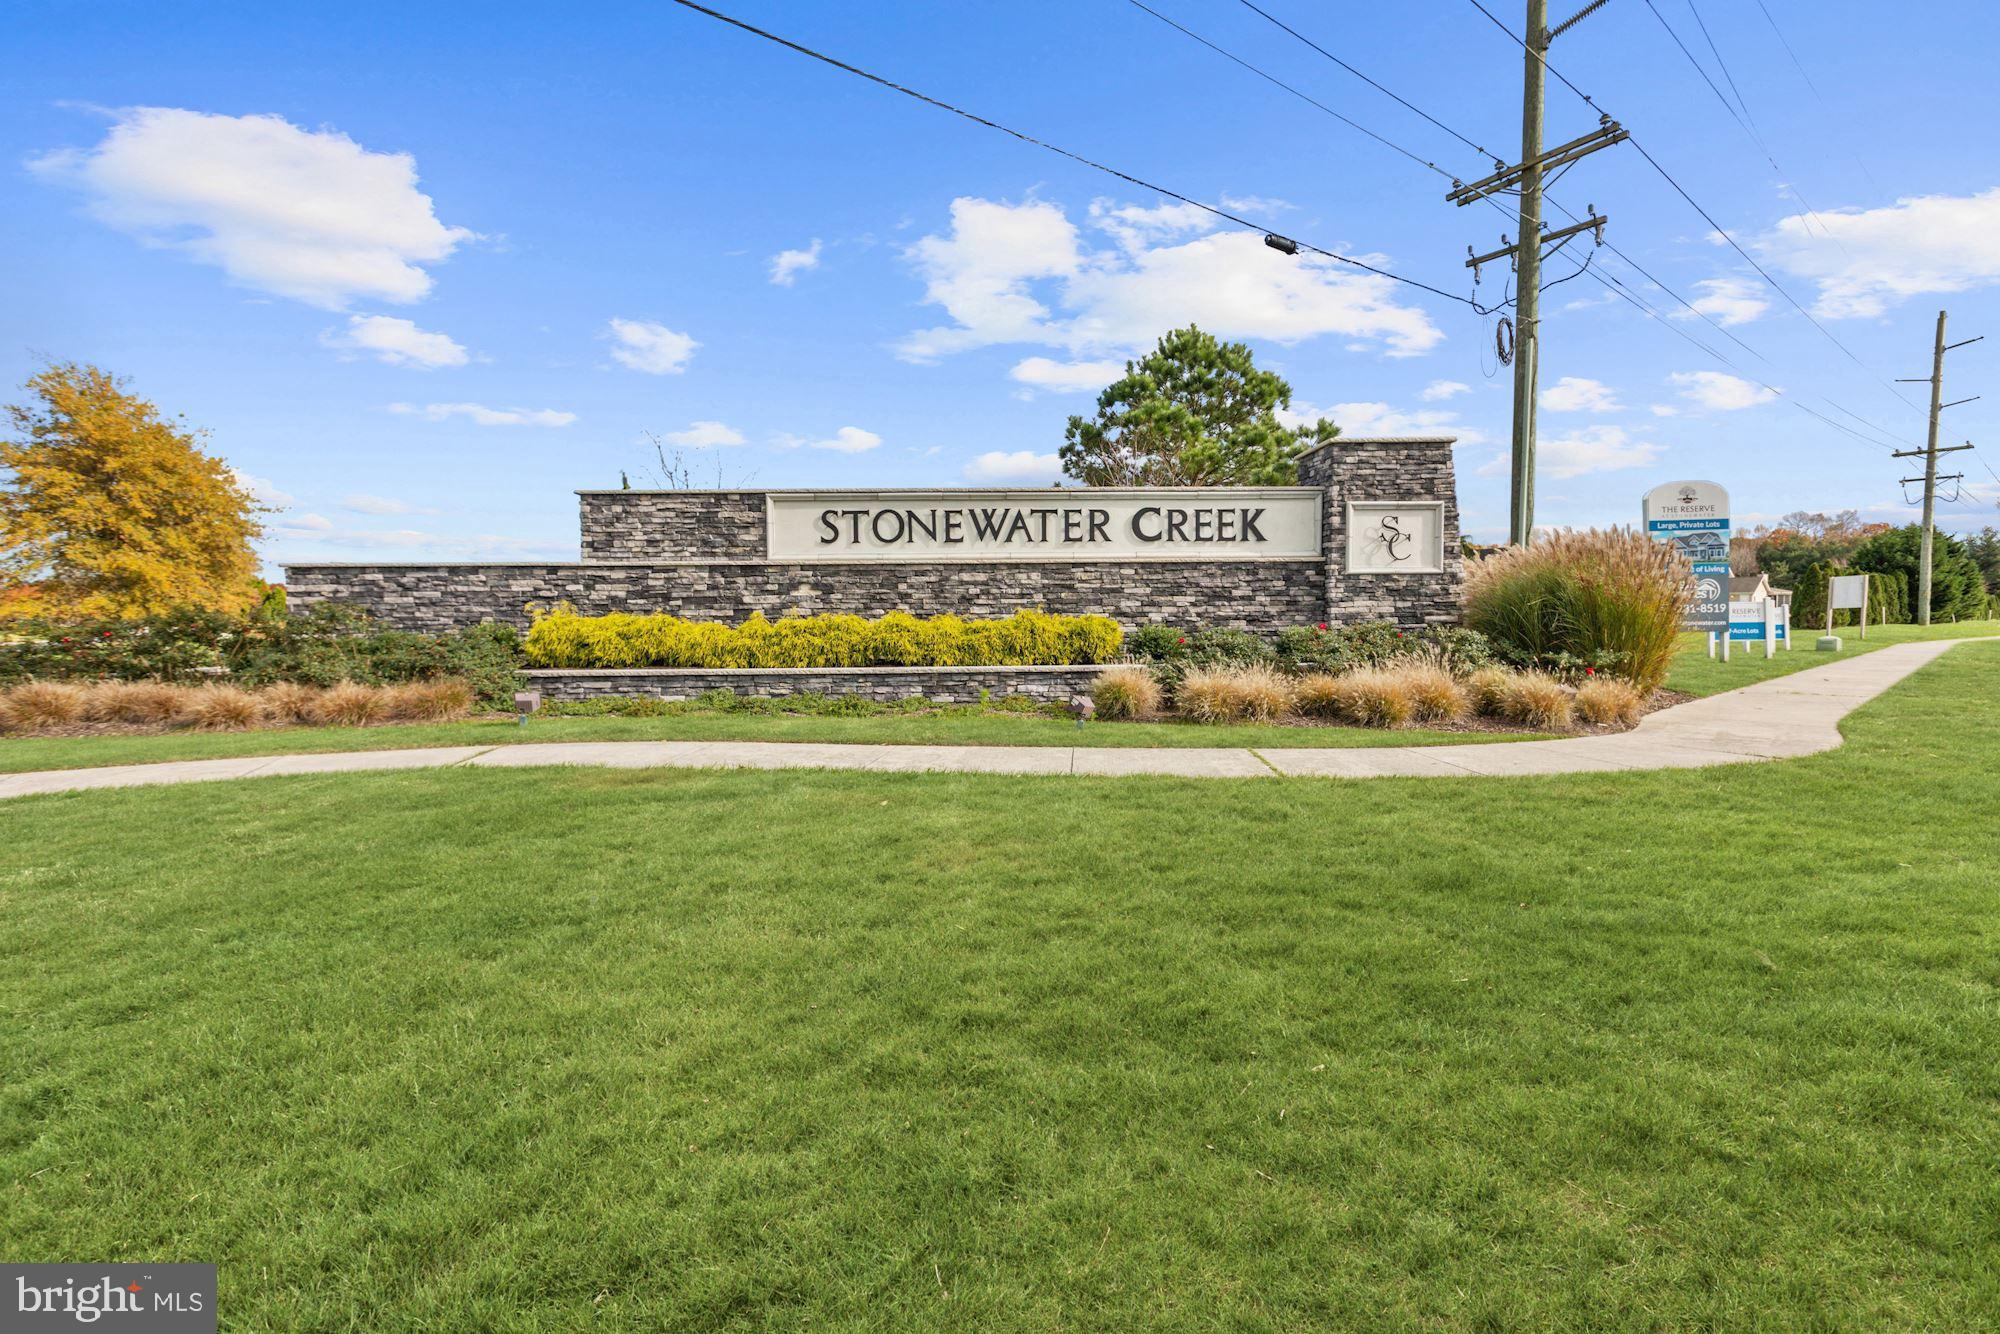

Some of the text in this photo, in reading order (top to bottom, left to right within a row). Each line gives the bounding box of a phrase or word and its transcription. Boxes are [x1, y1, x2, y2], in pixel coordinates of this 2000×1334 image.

[1661, 504, 1716, 513] THE RESERVE
[820, 507, 1268, 544] STONEWATER CREEK
[1680, 521, 1704, 529] Private
[1705, 520, 1720, 528] Lots
[1695, 565, 1704, 573] of
[1704, 564, 1726, 574] Living
